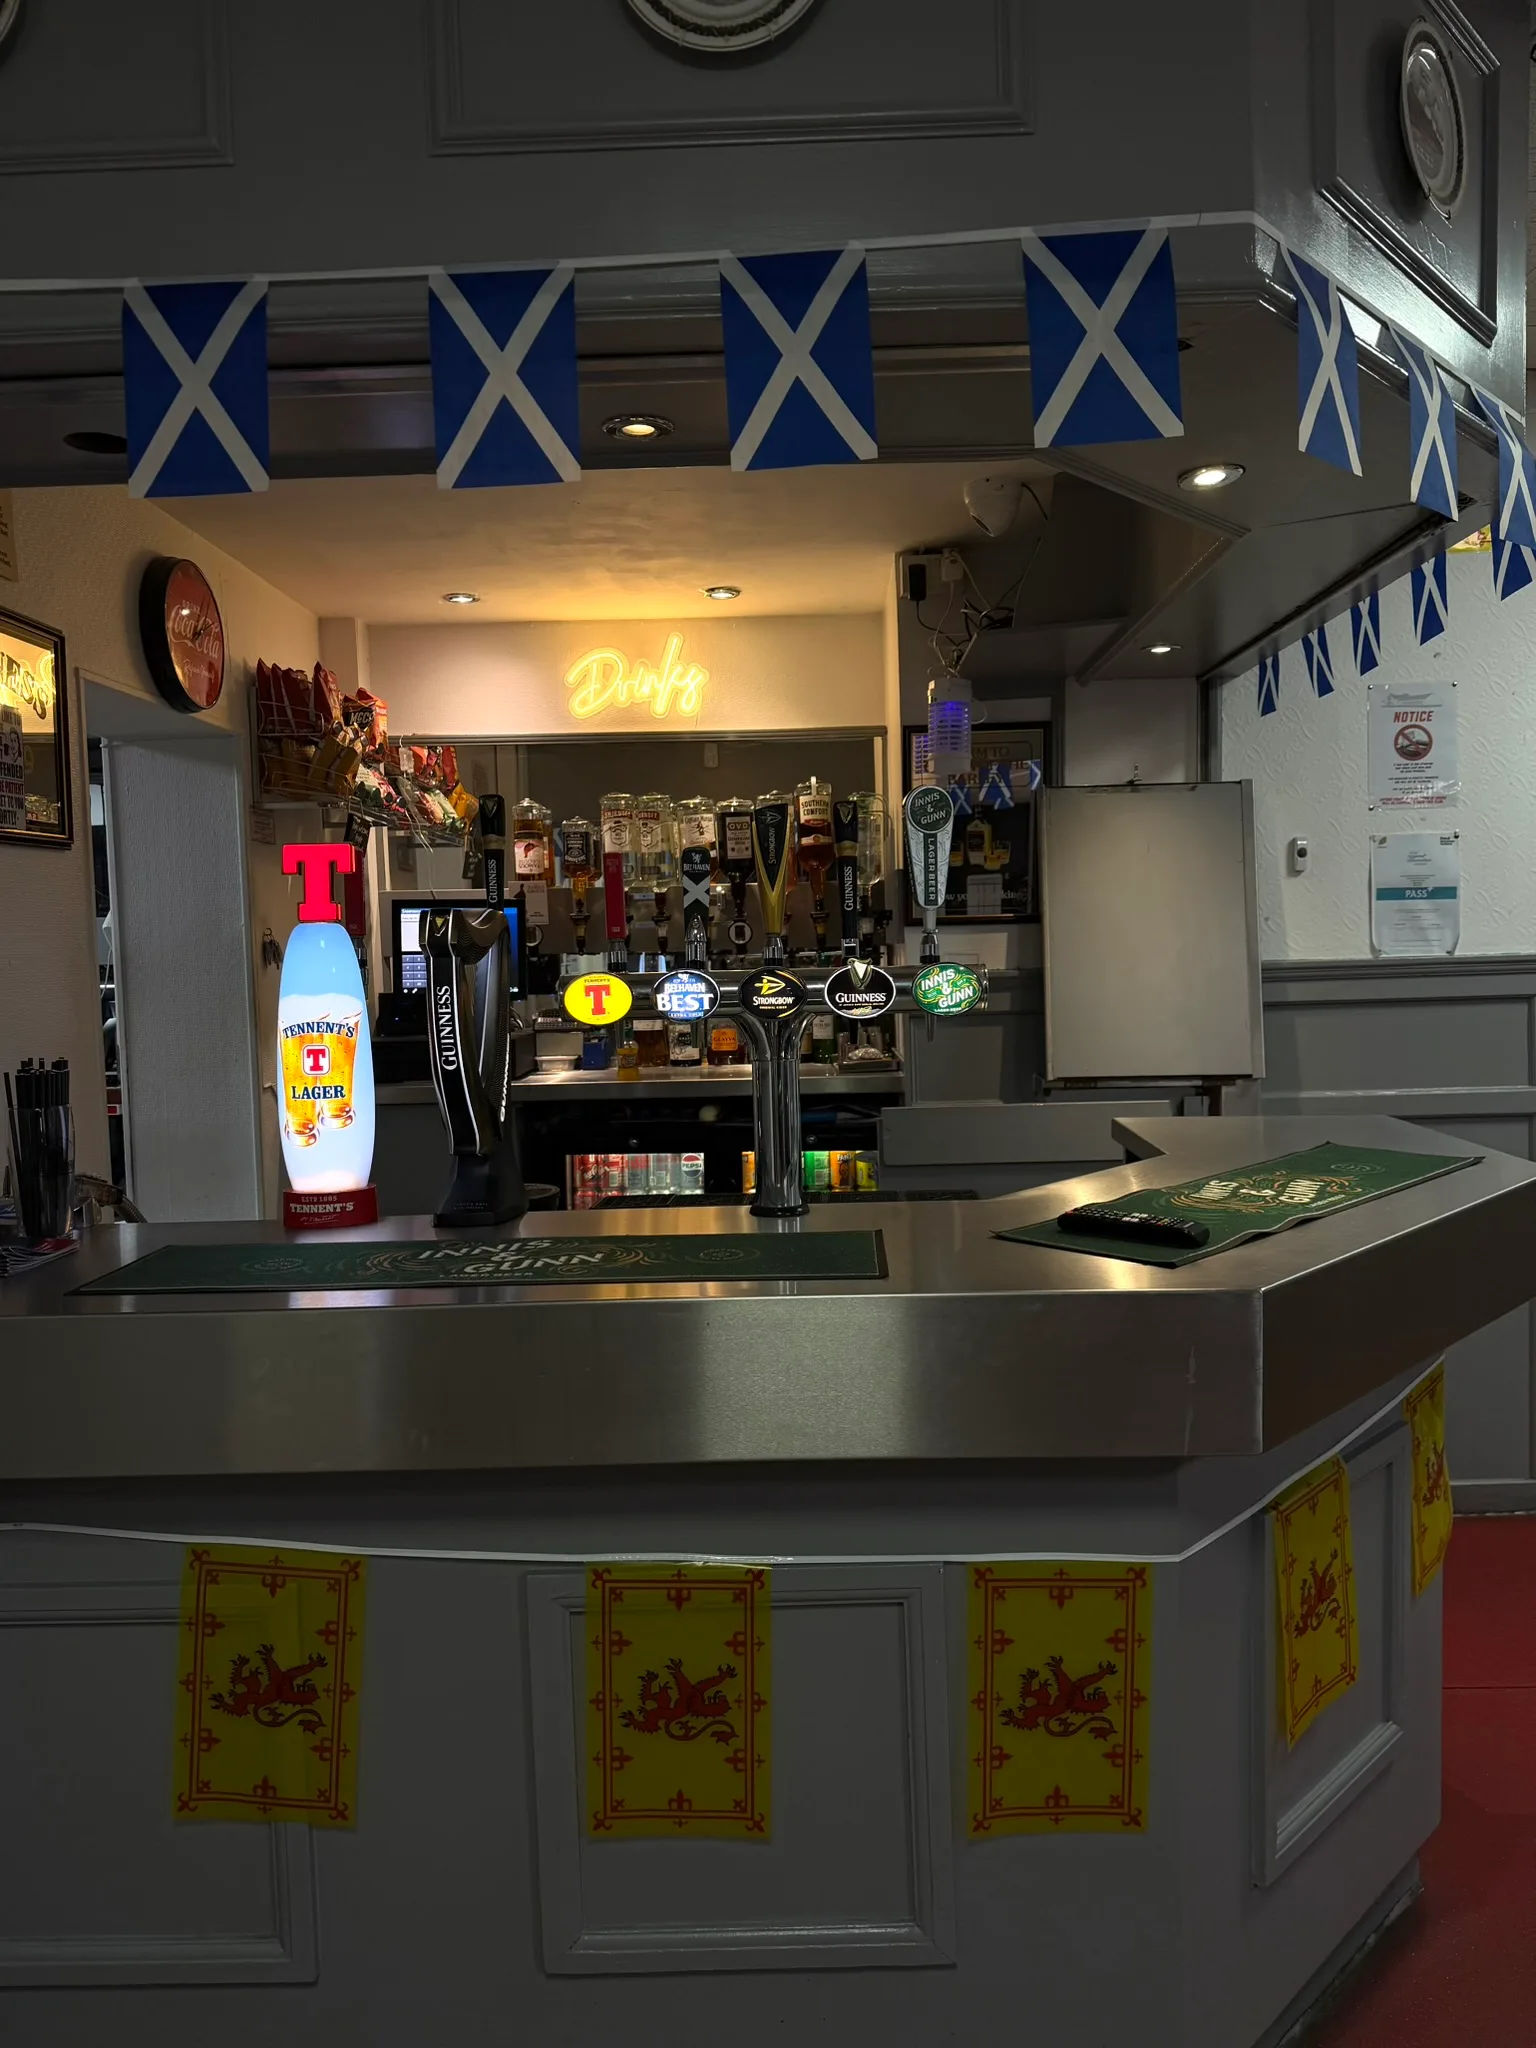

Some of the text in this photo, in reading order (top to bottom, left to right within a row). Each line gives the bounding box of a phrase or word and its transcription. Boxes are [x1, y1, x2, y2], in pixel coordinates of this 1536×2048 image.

[566, 634, 708, 717] Drinks
[1393, 710, 1434, 723] NOTICE
[800, 799, 829, 809] SOUTHERN
[915, 791, 940, 807] INNIS
[926, 803, 934, 812] &
[802, 808, 829, 817] COMFORT
[920, 810, 946, 824] GUNN
[769, 826, 777, 865] STRONGBOW
[683, 863, 711, 872] BELHAVEN
[928, 838, 936, 901] LAGER BEER
[282, 843, 355, 921] T
[488, 859, 498, 903] GUINNESS
[844, 866, 854, 911] GUINNESS
[1405, 889, 1428, 898] PASS
[664, 982, 706, 993] BELHAVEN
[921, 968, 956, 991] INNIS
[941, 981, 953, 995] &
[584, 984, 611, 1016] T
[656, 993, 715, 1012] BEST
[752, 995, 795, 1006] STRONGBOW
[835, 992, 887, 1003] GUINNESS
[938, 985, 974, 1008] GUNN
[282, 1021, 355, 1039] TENNENT'S
[437, 985, 459, 1071] GUINNESS
[306, 1048, 326, 1072] T
[291, 1085, 346, 1100] LAGER
[1278, 1179, 1325, 1204] GUNN
[289, 1202, 354, 1213] TENNENT'S
[417, 1239, 553, 1260] INNIS
[463, 1252, 605, 1274] GUNN
